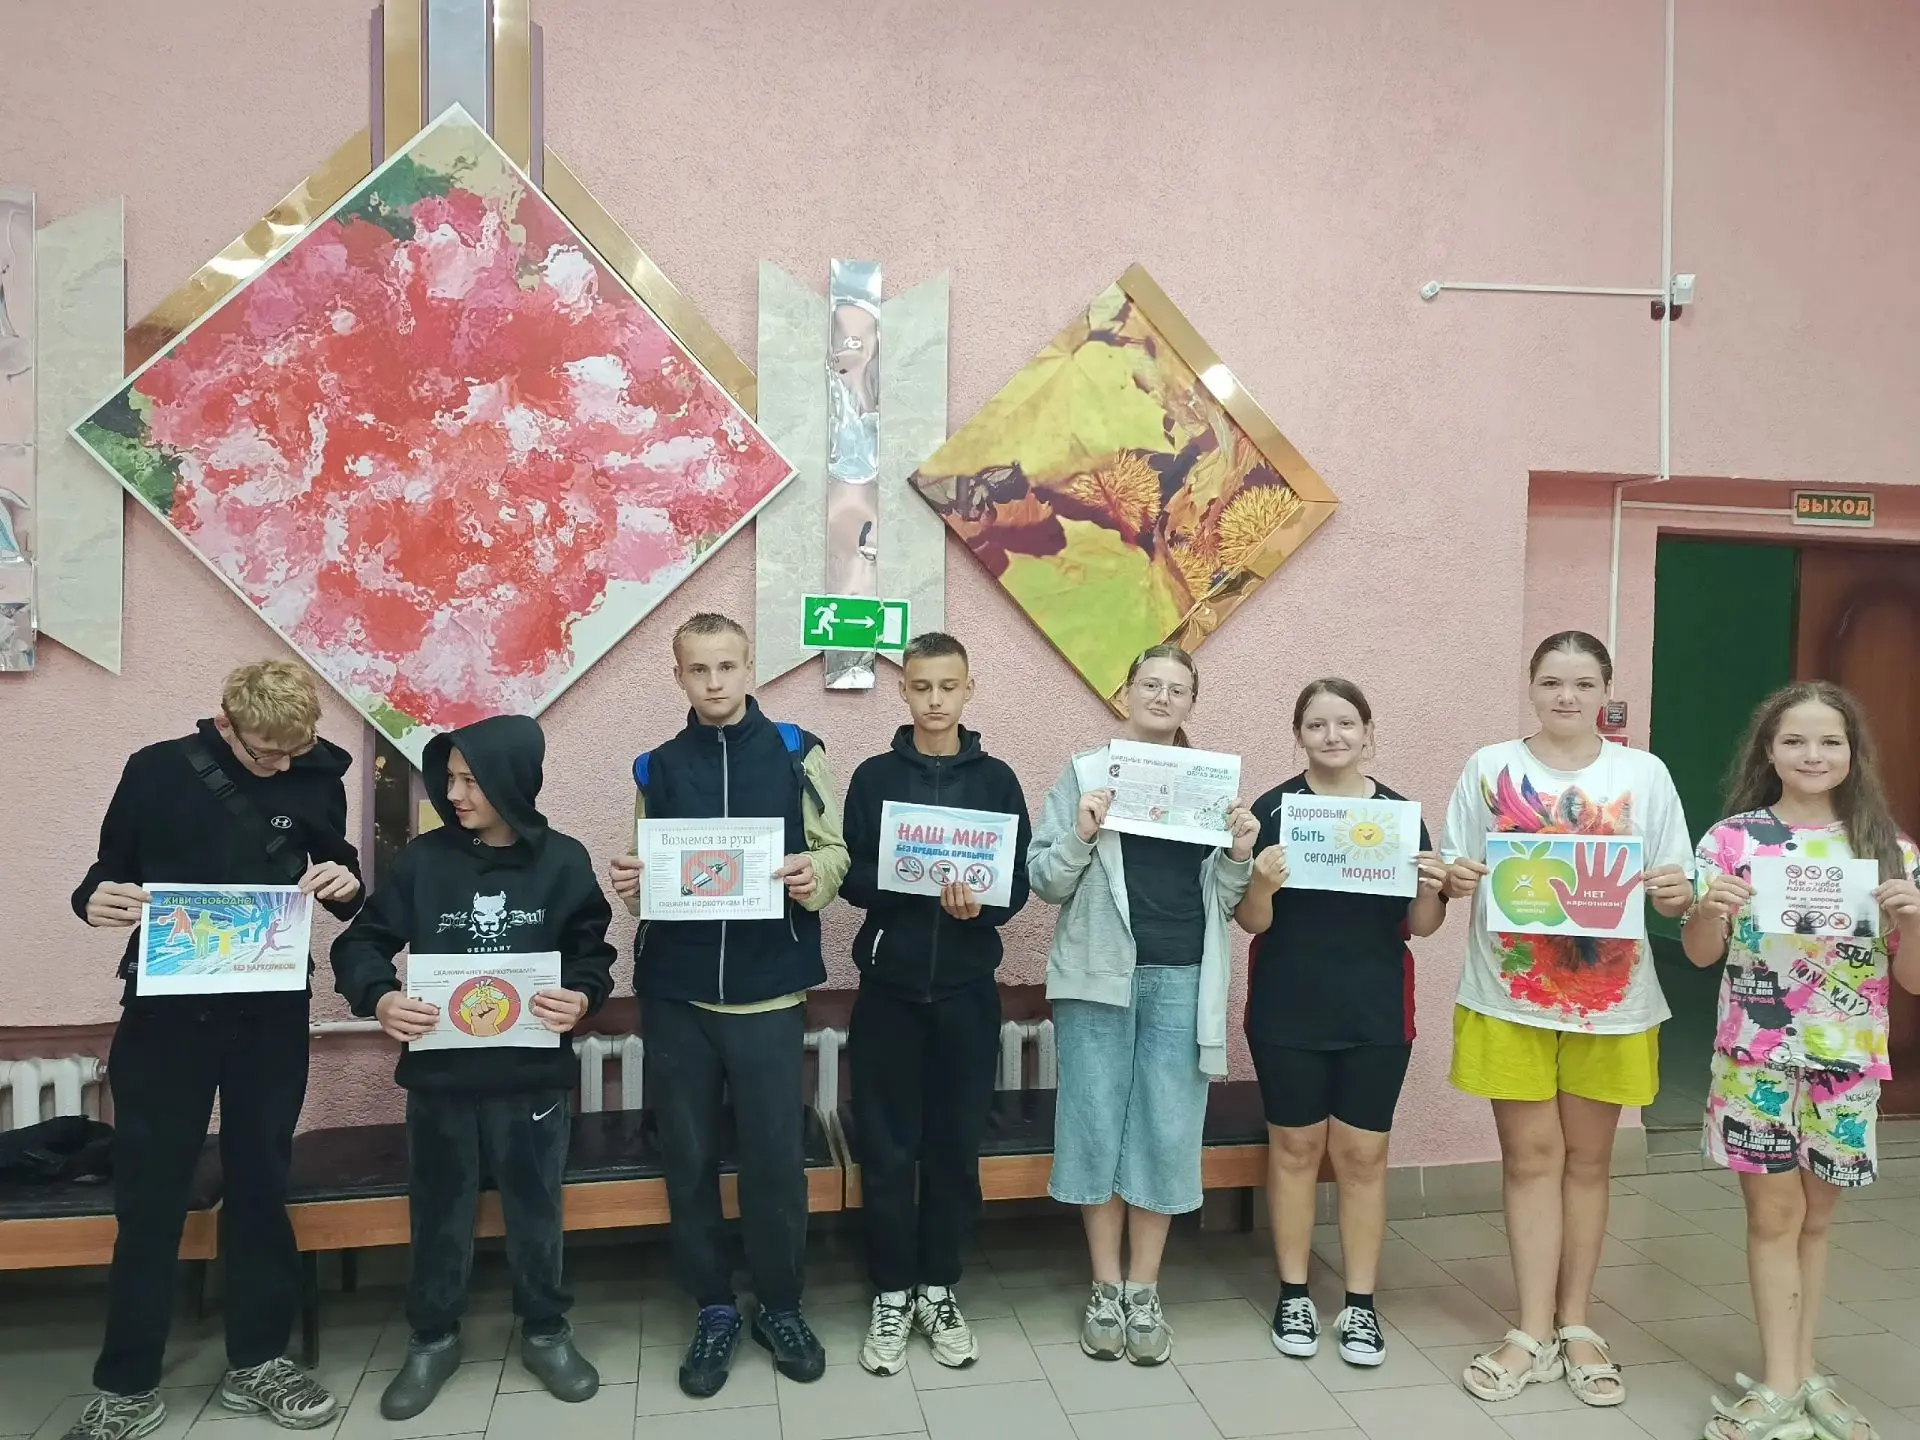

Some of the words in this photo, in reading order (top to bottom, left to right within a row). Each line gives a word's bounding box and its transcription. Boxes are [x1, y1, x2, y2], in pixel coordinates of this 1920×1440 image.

[1798, 497, 1869, 517] ВЫХОД
[1287, 804, 1347, 821] Здоровым
[716, 835, 727, 845] за
[730, 834, 756, 849] руки
[897, 822, 945, 845] НАШ
[951, 827, 998, 850] МИР
[1291, 826, 1326, 842] быть
[896, 844, 912, 852] БЕЗ
[1304, 851, 1347, 866] сегодня
[1341, 866, 1396, 882] модно!
[163, 896, 192, 905] ЖИВИ
[742, 897, 761, 906] НЕТ
[1583, 890, 1606, 899] НЕТ
[1566, 900, 1624, 908] наркотикам!
[466, 945, 512, 954] GERMANY
